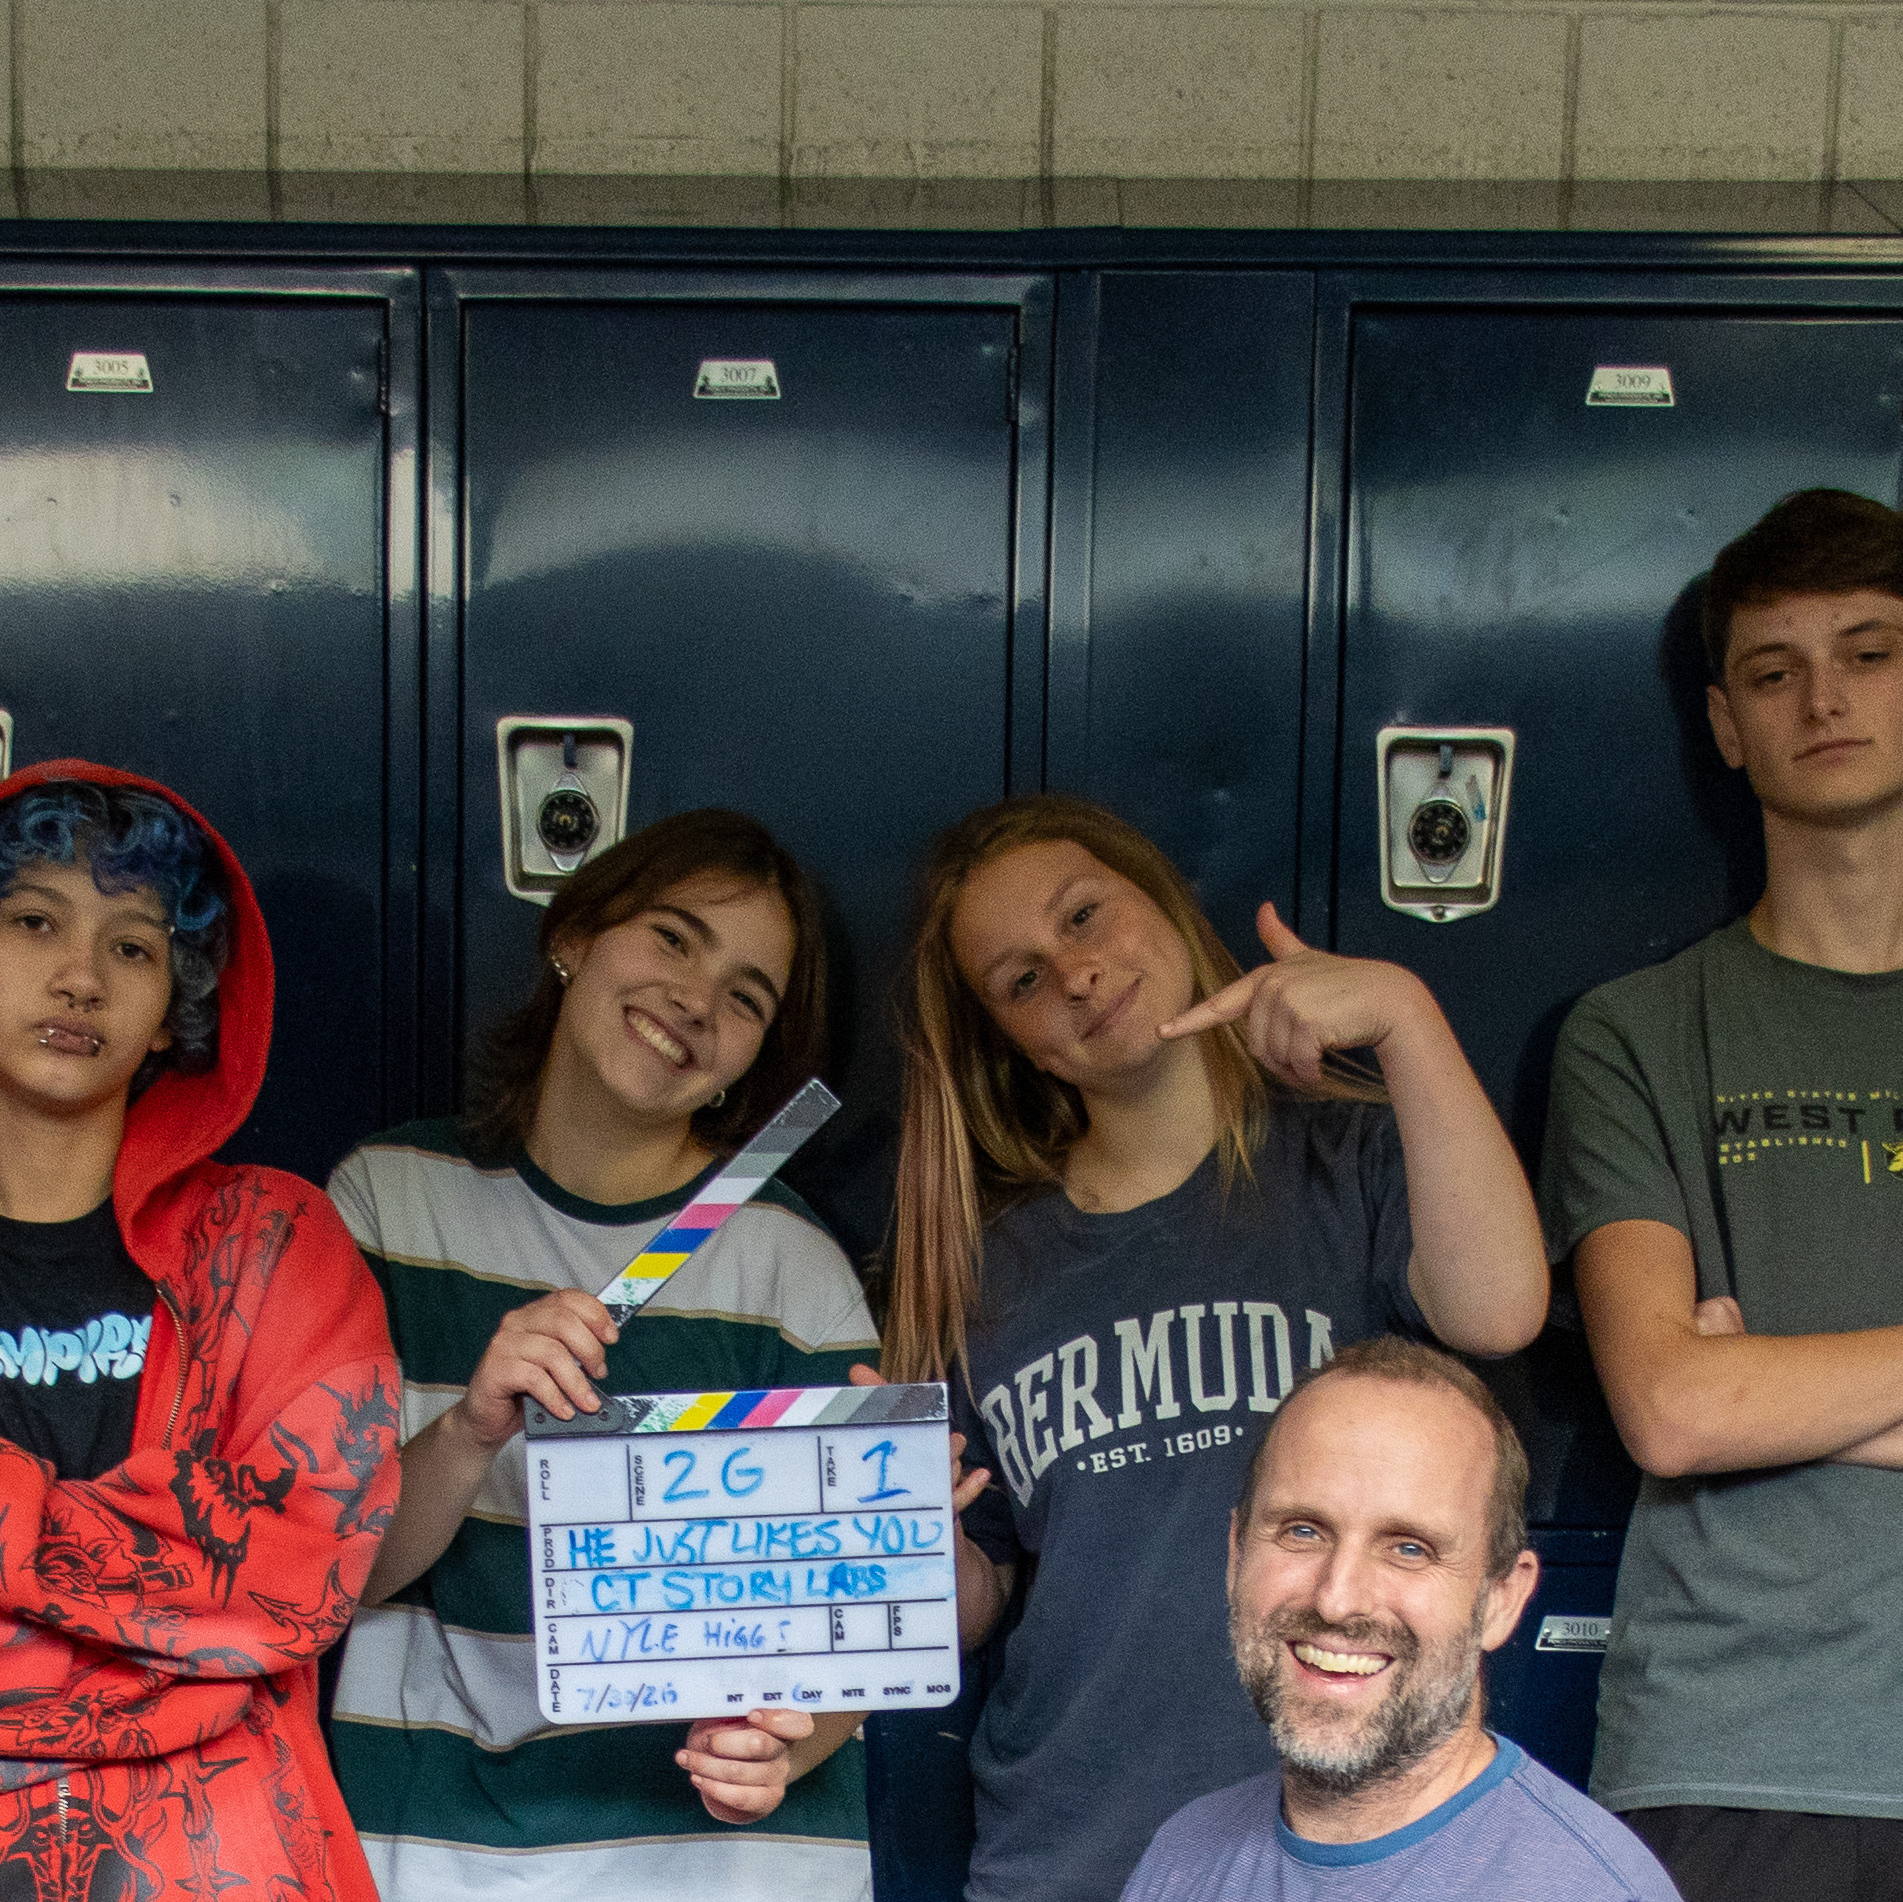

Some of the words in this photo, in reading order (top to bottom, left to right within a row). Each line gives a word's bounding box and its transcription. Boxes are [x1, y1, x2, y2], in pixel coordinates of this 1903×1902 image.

[95, 360, 127, 375] 3005
[723, 367, 757, 382] 3007
[1617, 374, 1651, 388] 3009
[1717, 1090, 1773, 1103] NITED
[1714, 1103, 1866, 1136] WEST
[1719, 1136, 1848, 1153] STABLISHED
[1719, 1152, 1756, 1165] 802
[1092, 1442, 1151, 1474] EST.
[1164, 1426, 1232, 1458] 1609
[539, 1459, 550, 1500] ROLL
[634, 1455, 645, 1506] SCENE
[826, 1446, 837, 1487] TAKE
[858, 1440, 911, 1503] 1
[544, 1528, 555, 1568] PROD
[568, 1528, 617, 1569] HE
[633, 1520, 728, 1564] JUST
[731, 1520, 841, 1558] LIKES
[853, 1515, 943, 1554] YOU
[545, 1578, 556, 1609] DIR
[592, 1571, 651, 1612] CT
[662, 1570, 791, 1610] STORY
[834, 1609, 845, 1640] CAM
[893, 1605, 903, 1636] FPS
[1563, 1622, 1598, 1637] 3010
[548, 1623, 559, 1654] CAM
[550, 1669, 561, 1713] DATE
[727, 1693, 744, 1703] INT
[763, 1692, 783, 1701] EXT
[802, 1690, 822, 1700] DAY
[842, 1688, 866, 1698] NITE
[883, 1686, 911, 1696] SYNC
[926, 1684, 951, 1694] MOS
